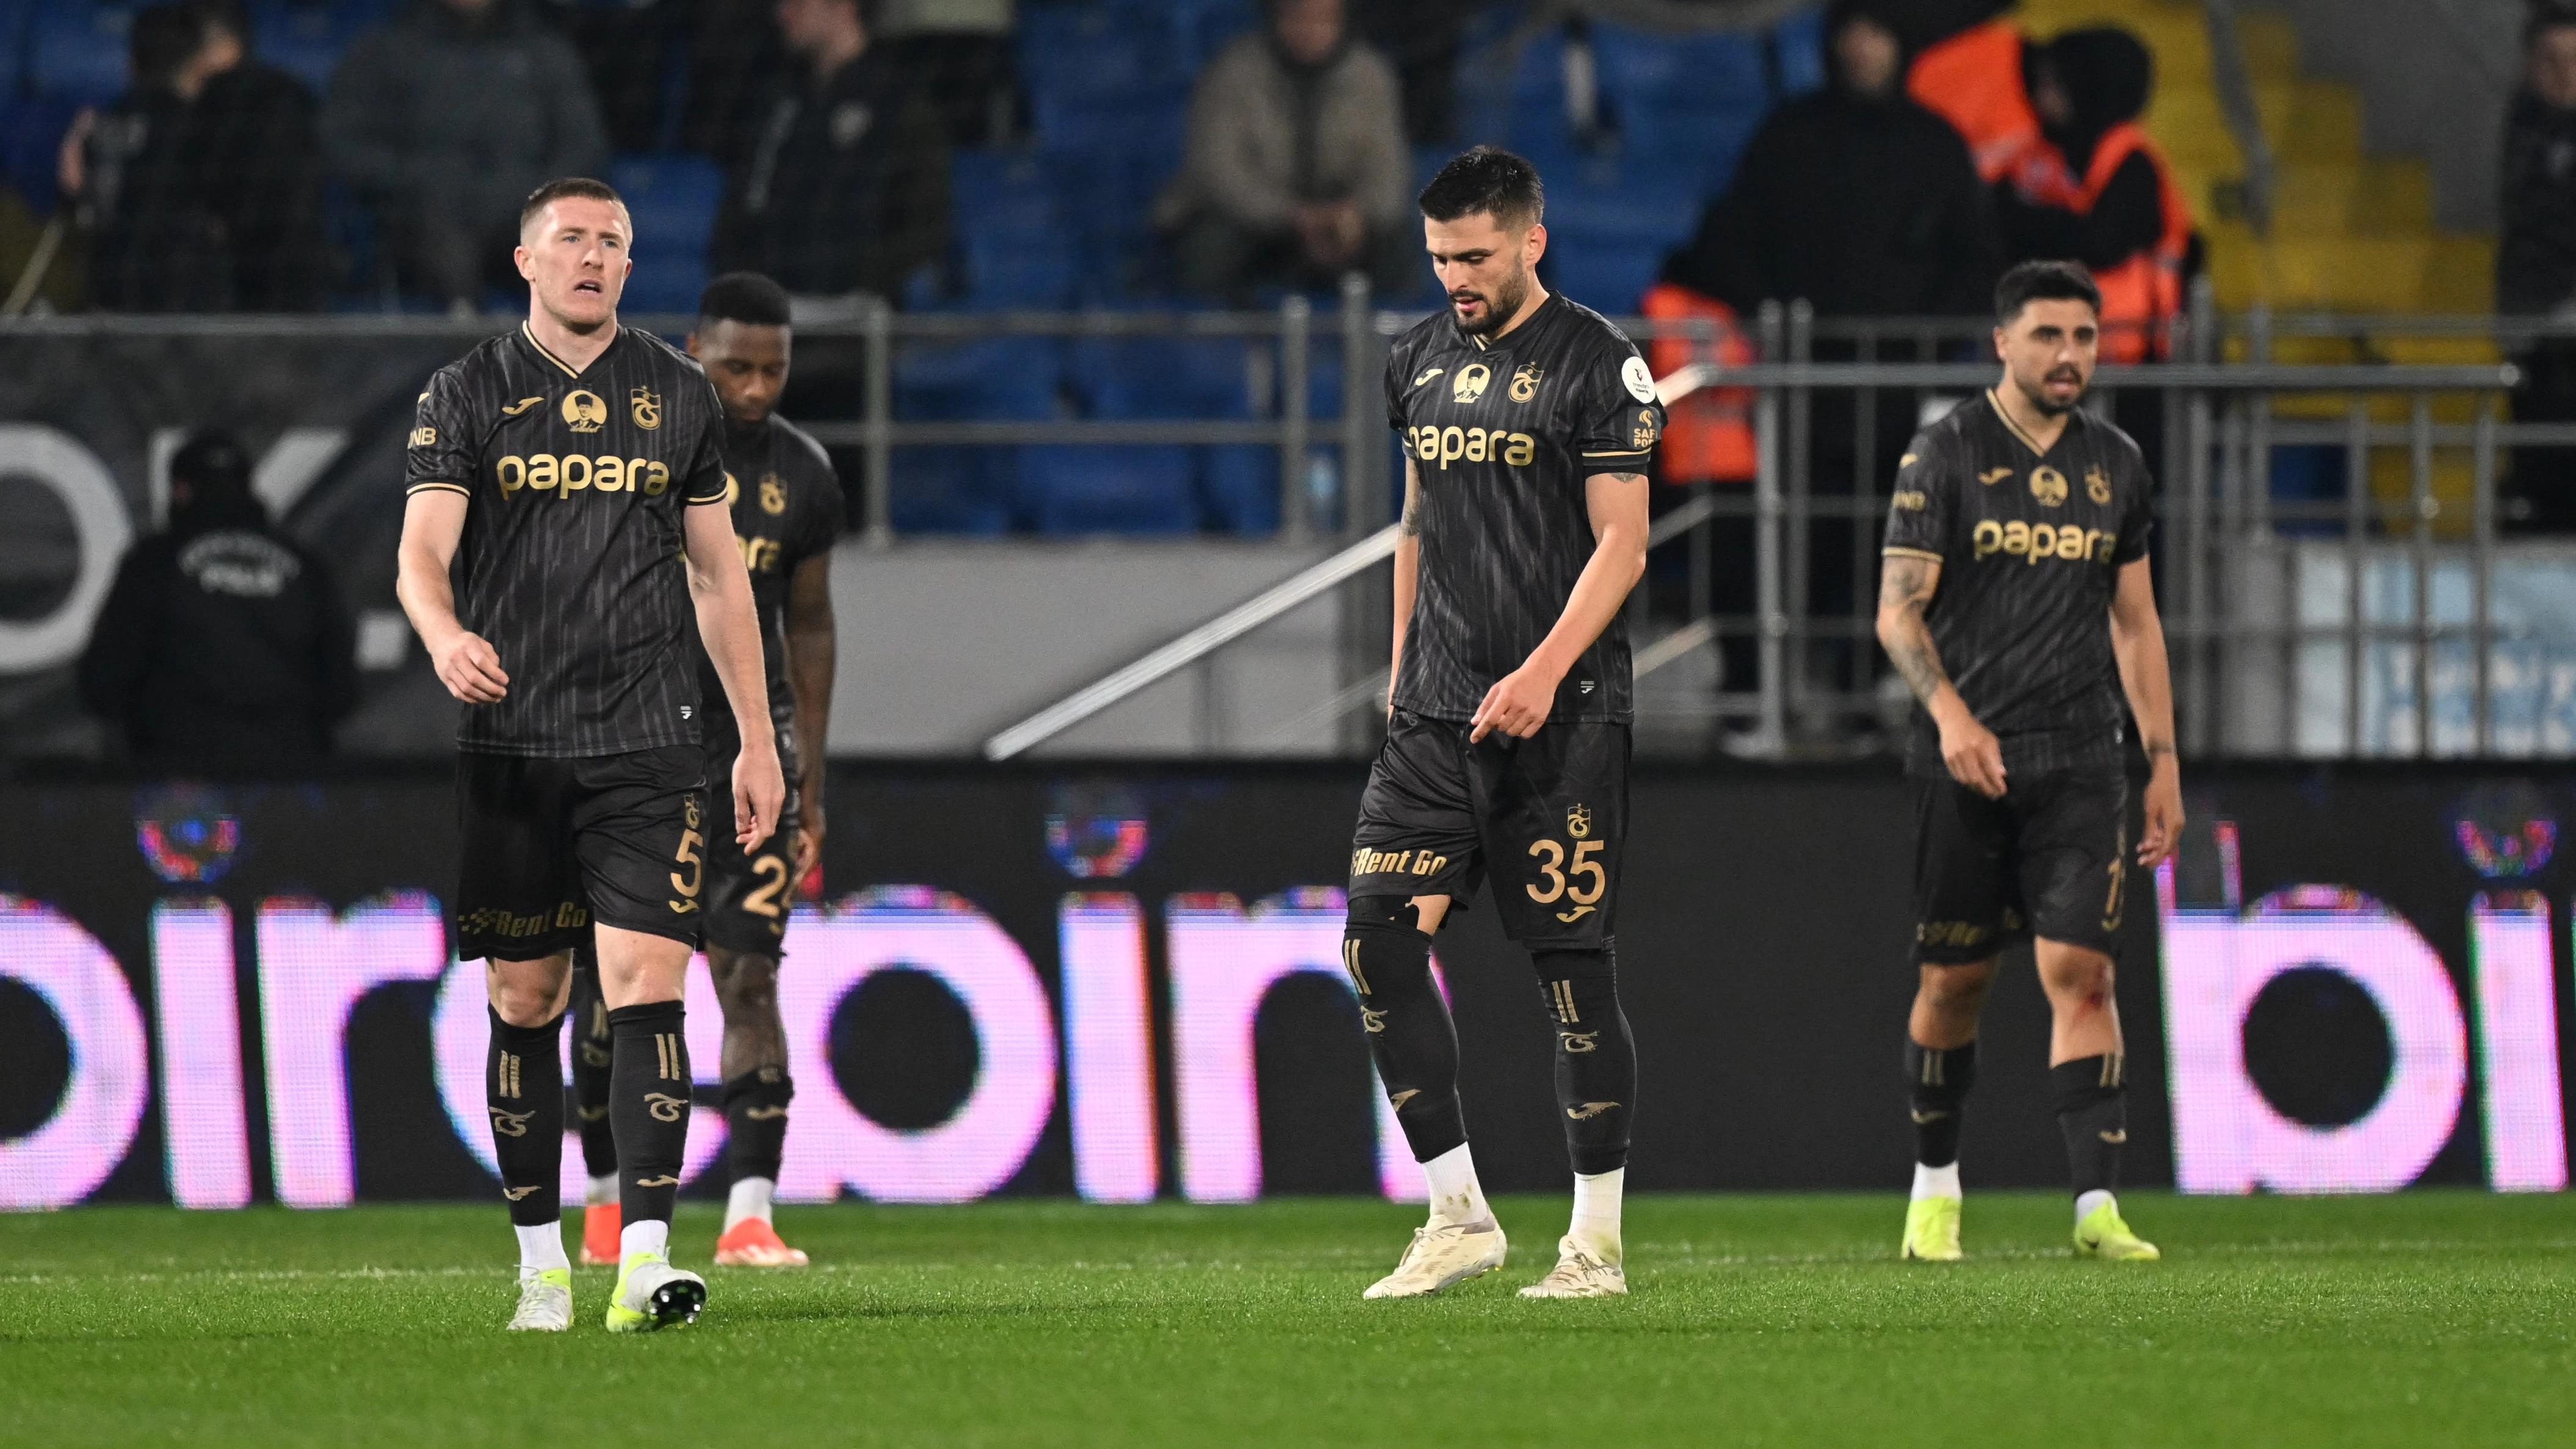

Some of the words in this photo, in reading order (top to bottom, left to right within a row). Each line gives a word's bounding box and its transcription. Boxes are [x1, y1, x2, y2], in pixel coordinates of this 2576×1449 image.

[407, 427, 437, 450] NB
[496, 453, 670, 501] papara
[1972, 519, 2118, 566] papara
[670, 828, 703, 897] 5
[742, 855, 792, 917] 2
[1354, 847, 1411, 876] Rent
[1411, 849, 1448, 876] Go
[1525, 838, 1606, 905] 35
[2105, 855, 2126, 915] 1
[555, 900, 587, 928] Go
[2154, 815, 2576, 1196] bi
